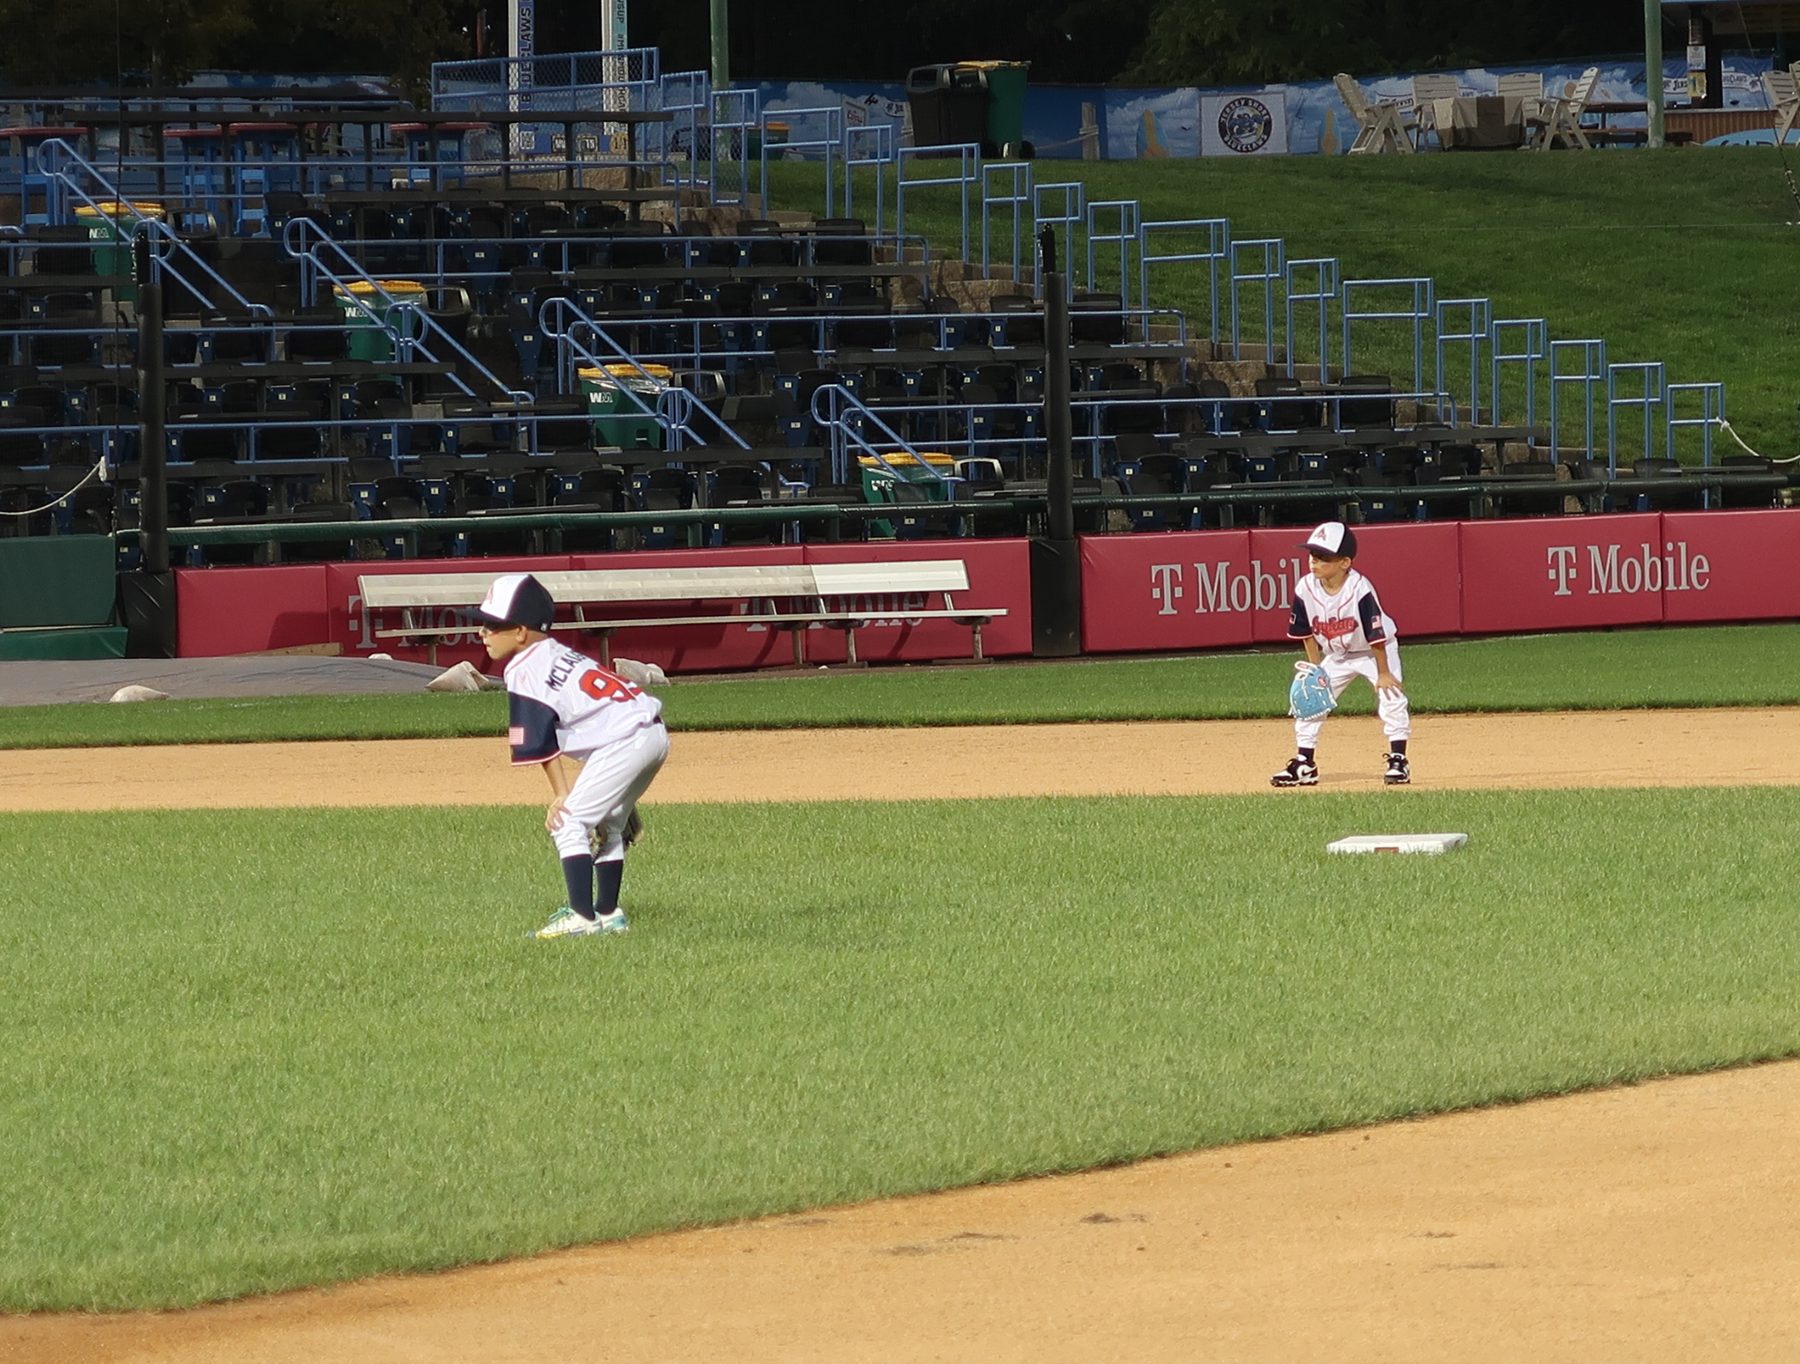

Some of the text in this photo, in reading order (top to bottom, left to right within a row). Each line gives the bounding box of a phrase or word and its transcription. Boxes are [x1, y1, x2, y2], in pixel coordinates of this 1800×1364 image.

[520, 7, 532, 103] BUELAWS
[1221, 99, 1270, 122] JERSEY SHORE
[1223, 134, 1268, 151] BLUECLAWS
[1193, 557, 1301, 614] Mobil
[1587, 541, 1710, 594] Mobile
